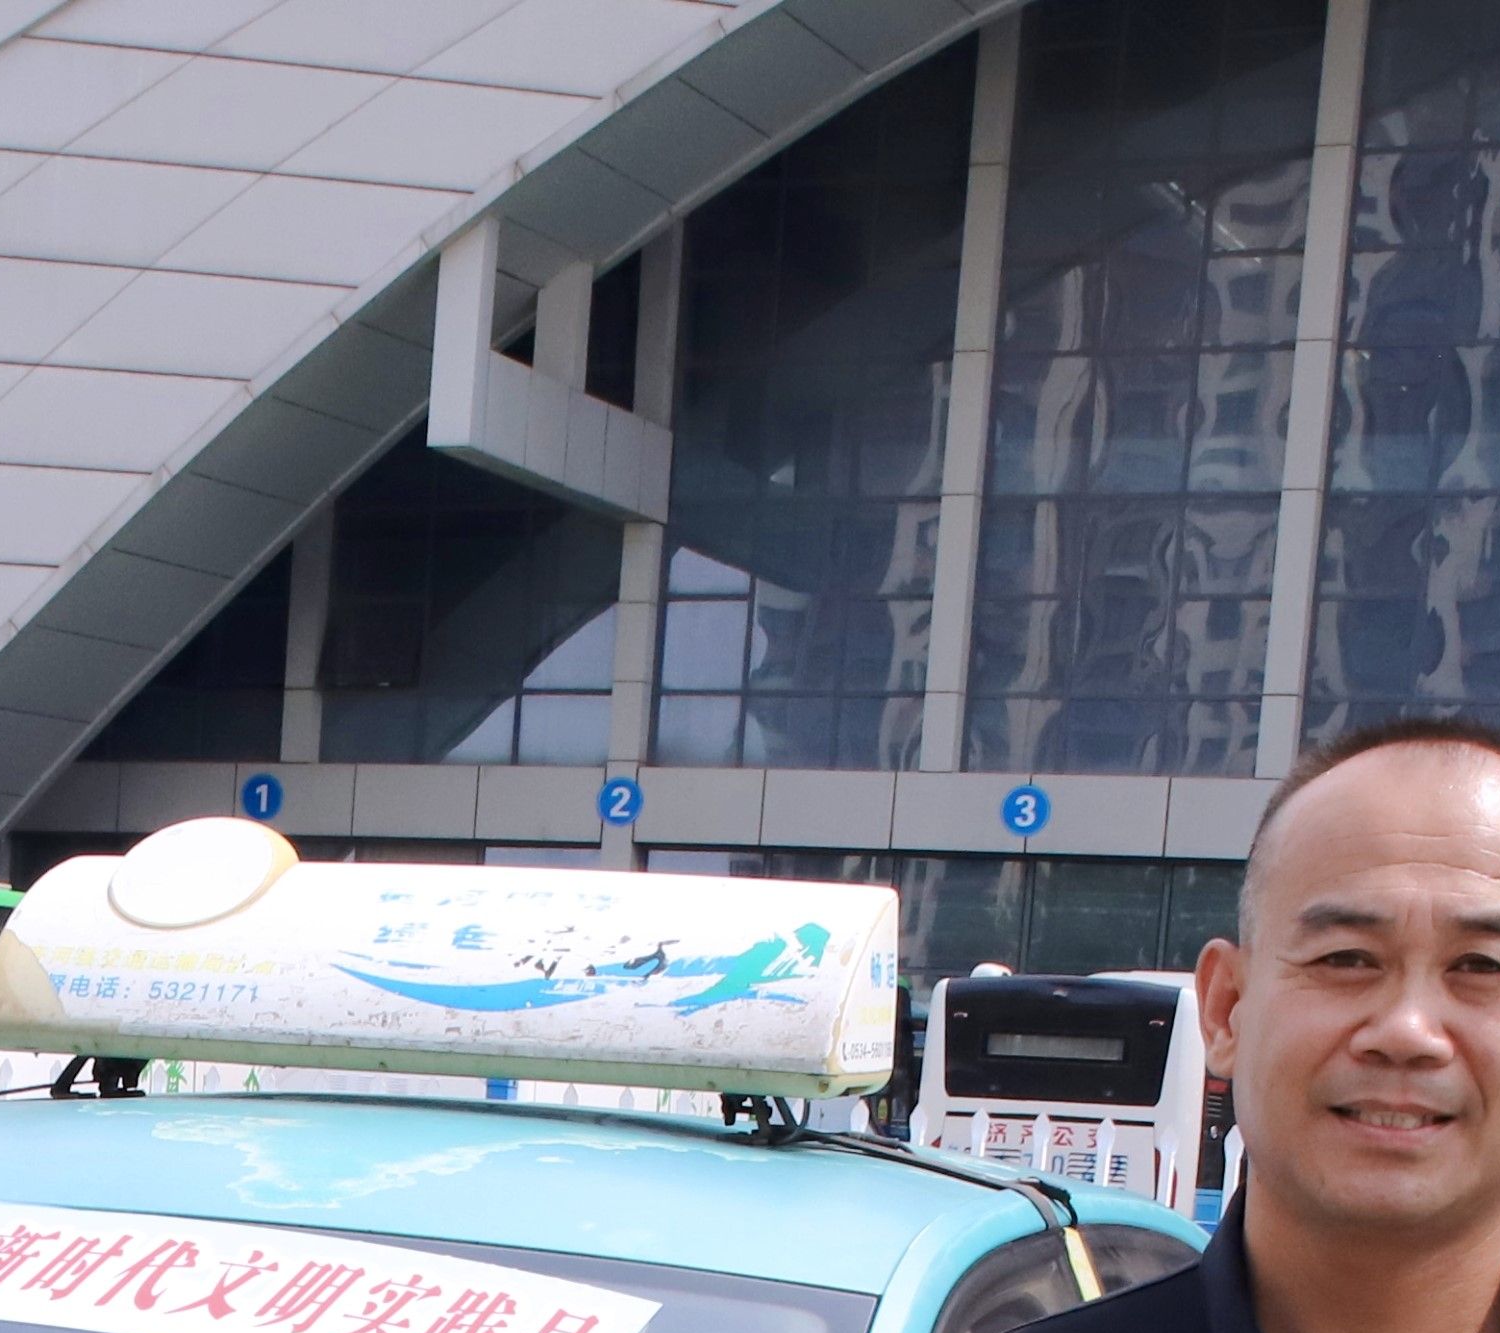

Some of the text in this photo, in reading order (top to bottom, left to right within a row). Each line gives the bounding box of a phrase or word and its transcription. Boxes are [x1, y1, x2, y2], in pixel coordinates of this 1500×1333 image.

[254, 782, 271, 813] 1
[610, 786, 632, 817] 2
[1014, 793, 1037, 828] 3
